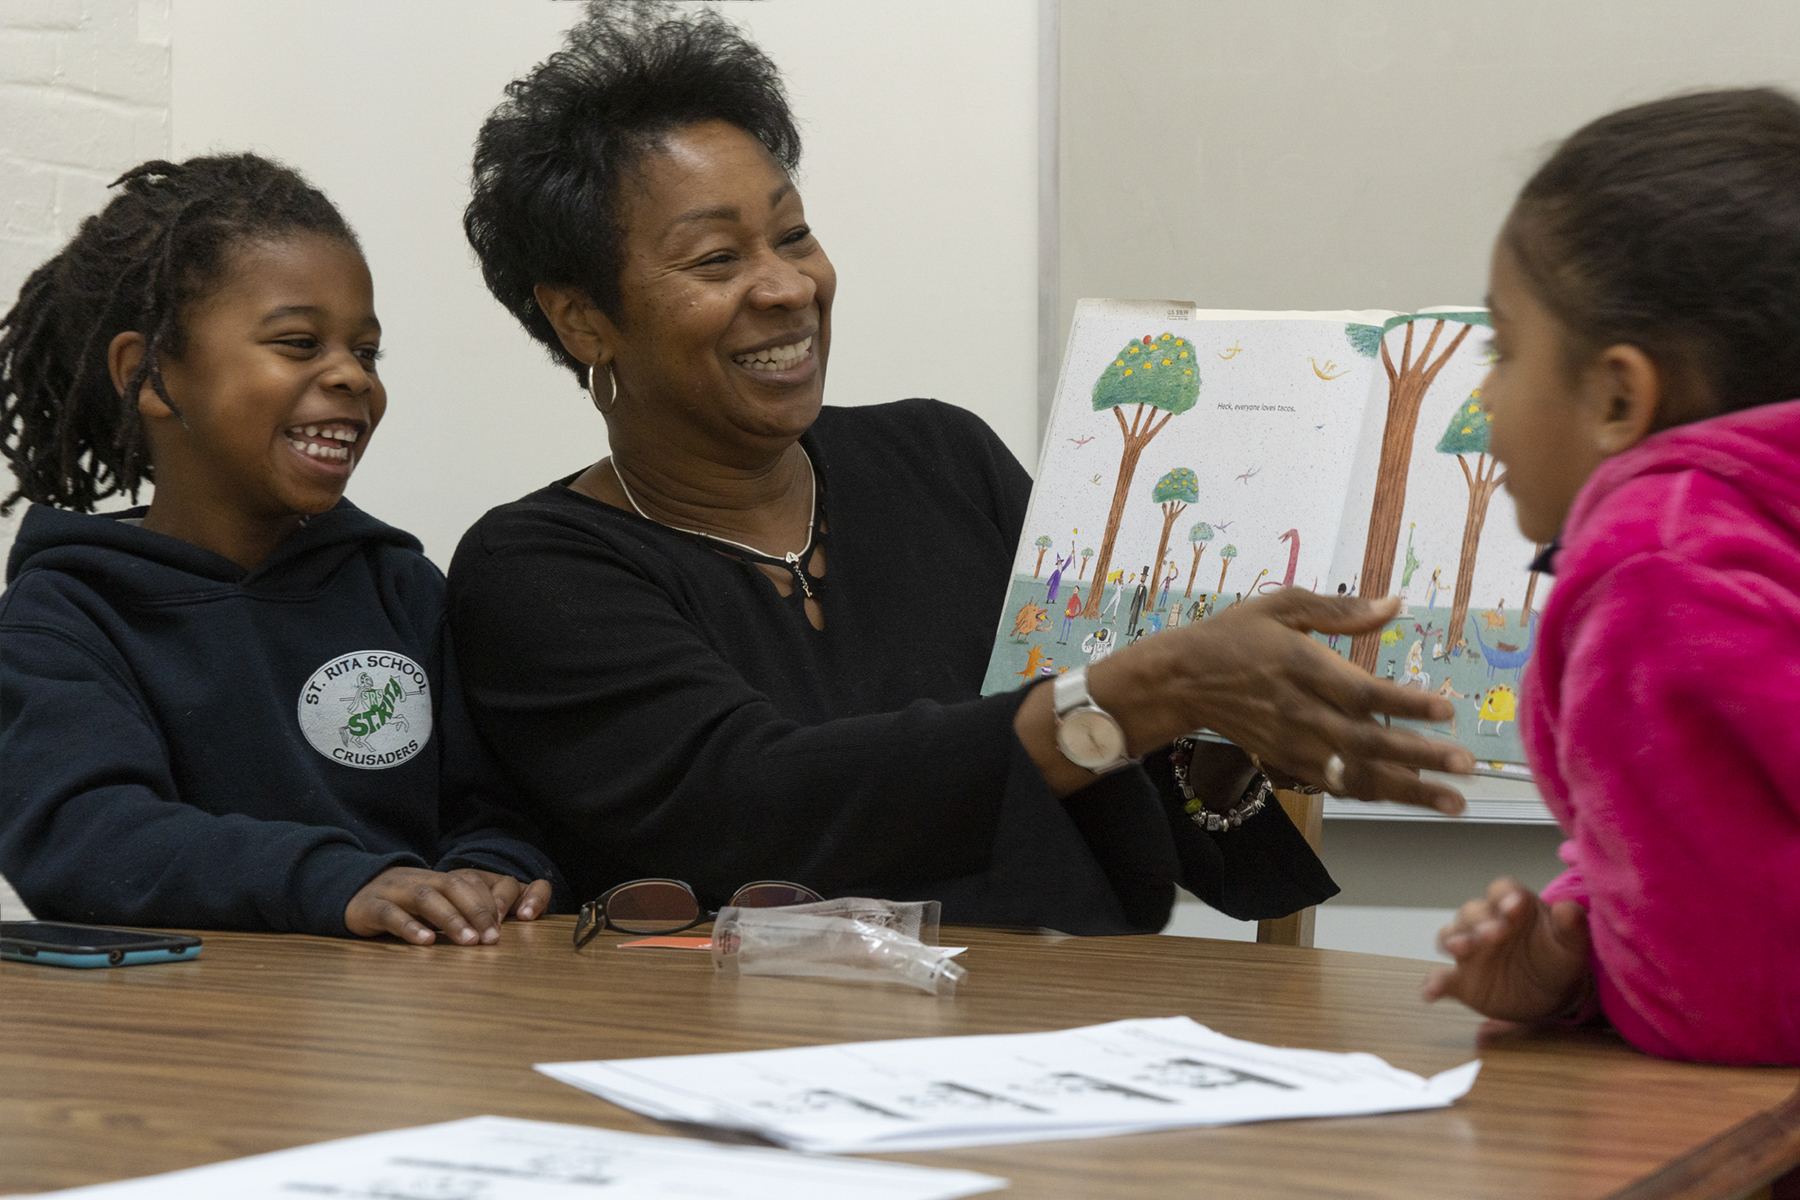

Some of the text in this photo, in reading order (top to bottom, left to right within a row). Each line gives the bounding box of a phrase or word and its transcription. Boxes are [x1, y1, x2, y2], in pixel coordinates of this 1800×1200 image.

[1217, 402, 1296, 412] Heck, everyone loves tacos.
[306, 655, 427, 704] ST. RITA SCHOOL
[332, 739, 418, 765] CRUSADERS
